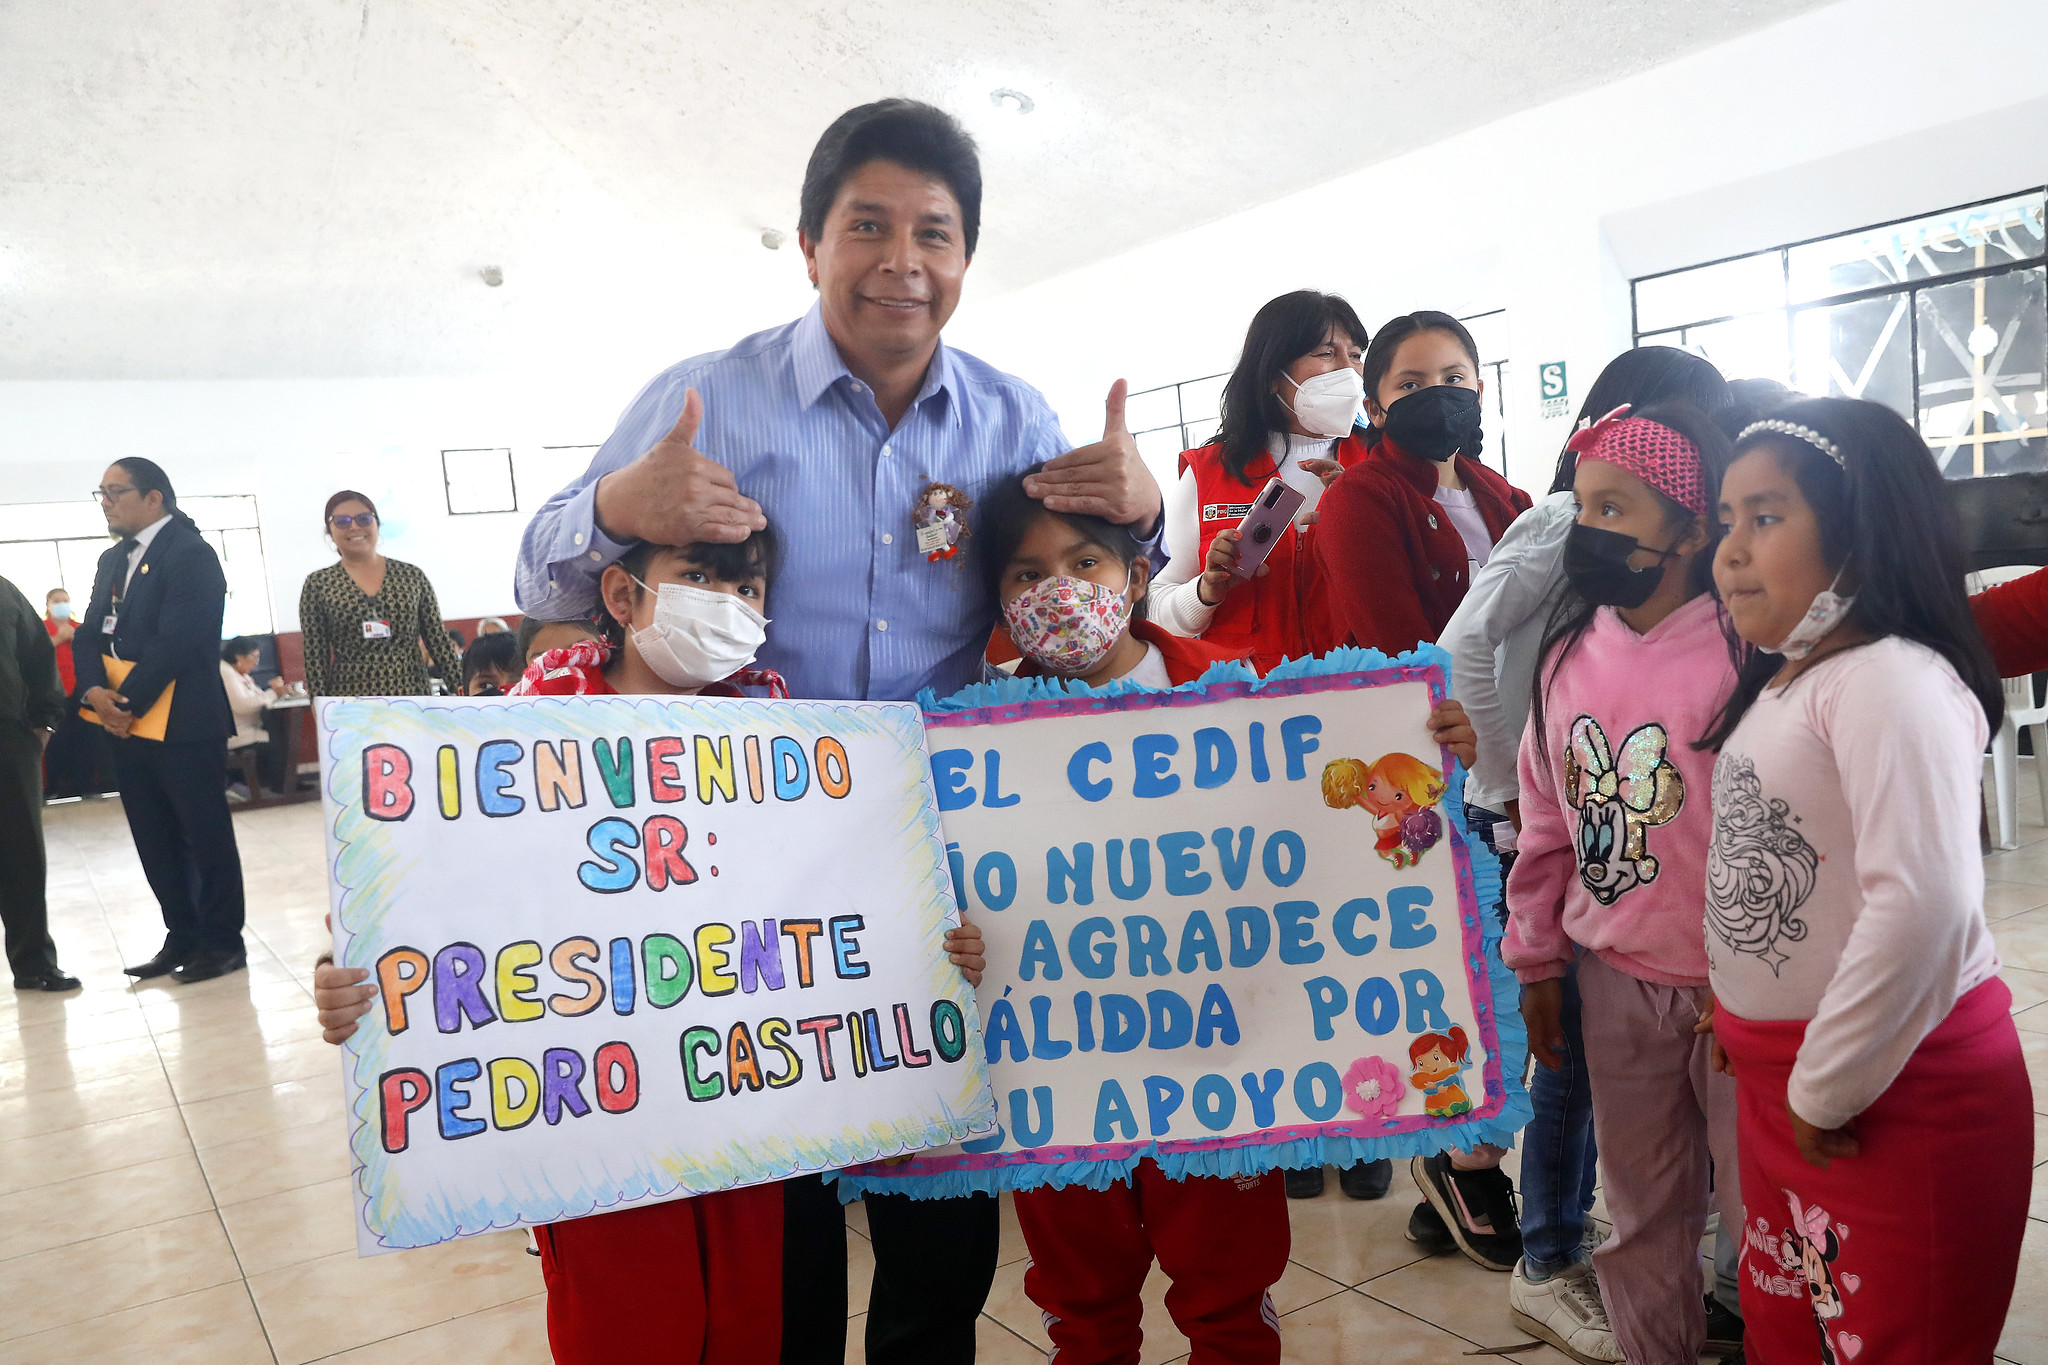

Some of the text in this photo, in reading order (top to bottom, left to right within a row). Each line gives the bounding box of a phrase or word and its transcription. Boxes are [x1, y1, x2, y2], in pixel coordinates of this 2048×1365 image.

[1543, 364, 1564, 396] S
[361, 735, 853, 821] BIENVENIDO
[930, 714, 1323, 812] EL CEDIF
[577, 815, 721, 894] SR:
[1046, 826, 1306, 906] NUEVO
[376, 914, 871, 1036] PRESIDENTE
[1019, 886, 1438, 982] AGRADECE
[1304, 969, 1451, 1041] POR
[379, 1000, 967, 1154] PEDRO CASTILLO
[1093, 1061, 1343, 1143] APOYO
[1237, 1179, 1261, 1192] SPORTS
